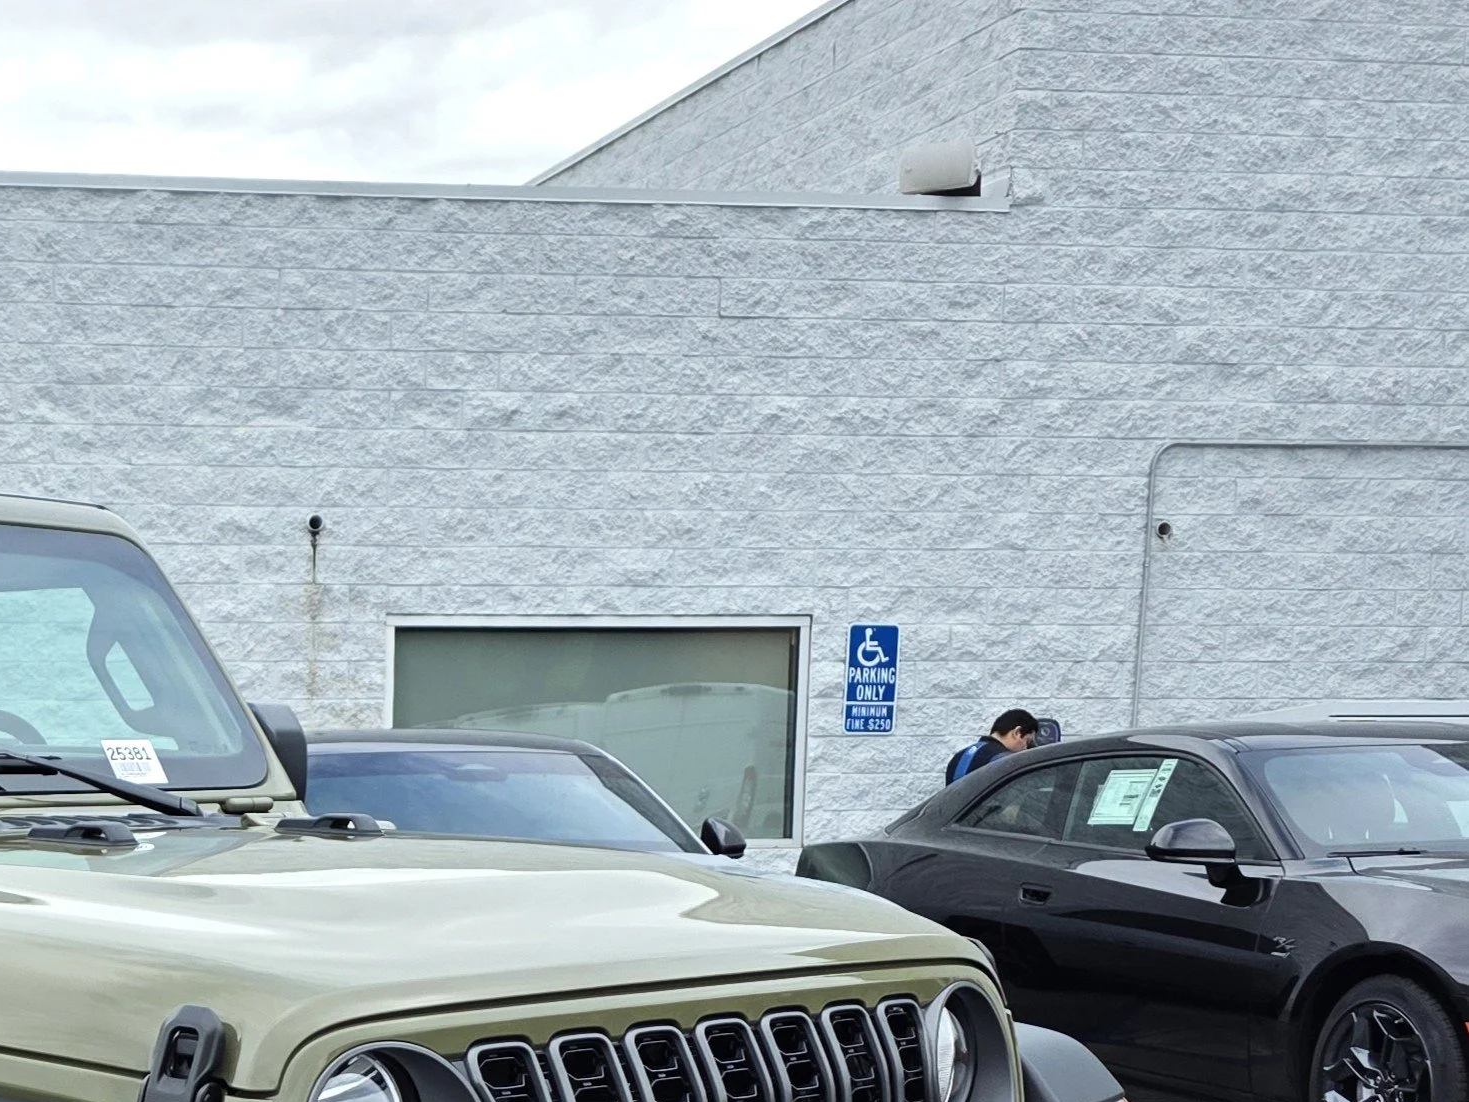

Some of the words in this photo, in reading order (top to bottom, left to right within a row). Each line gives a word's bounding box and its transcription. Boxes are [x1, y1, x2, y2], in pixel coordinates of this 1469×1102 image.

[848, 667, 896, 684] PARKING
[856, 685, 885, 700] ONLY
[851, 706, 887, 717] MINIMUM
[846, 718, 864, 730] FINE
[867, 718, 891, 731] $250
[107, 746, 152, 761] 25381
